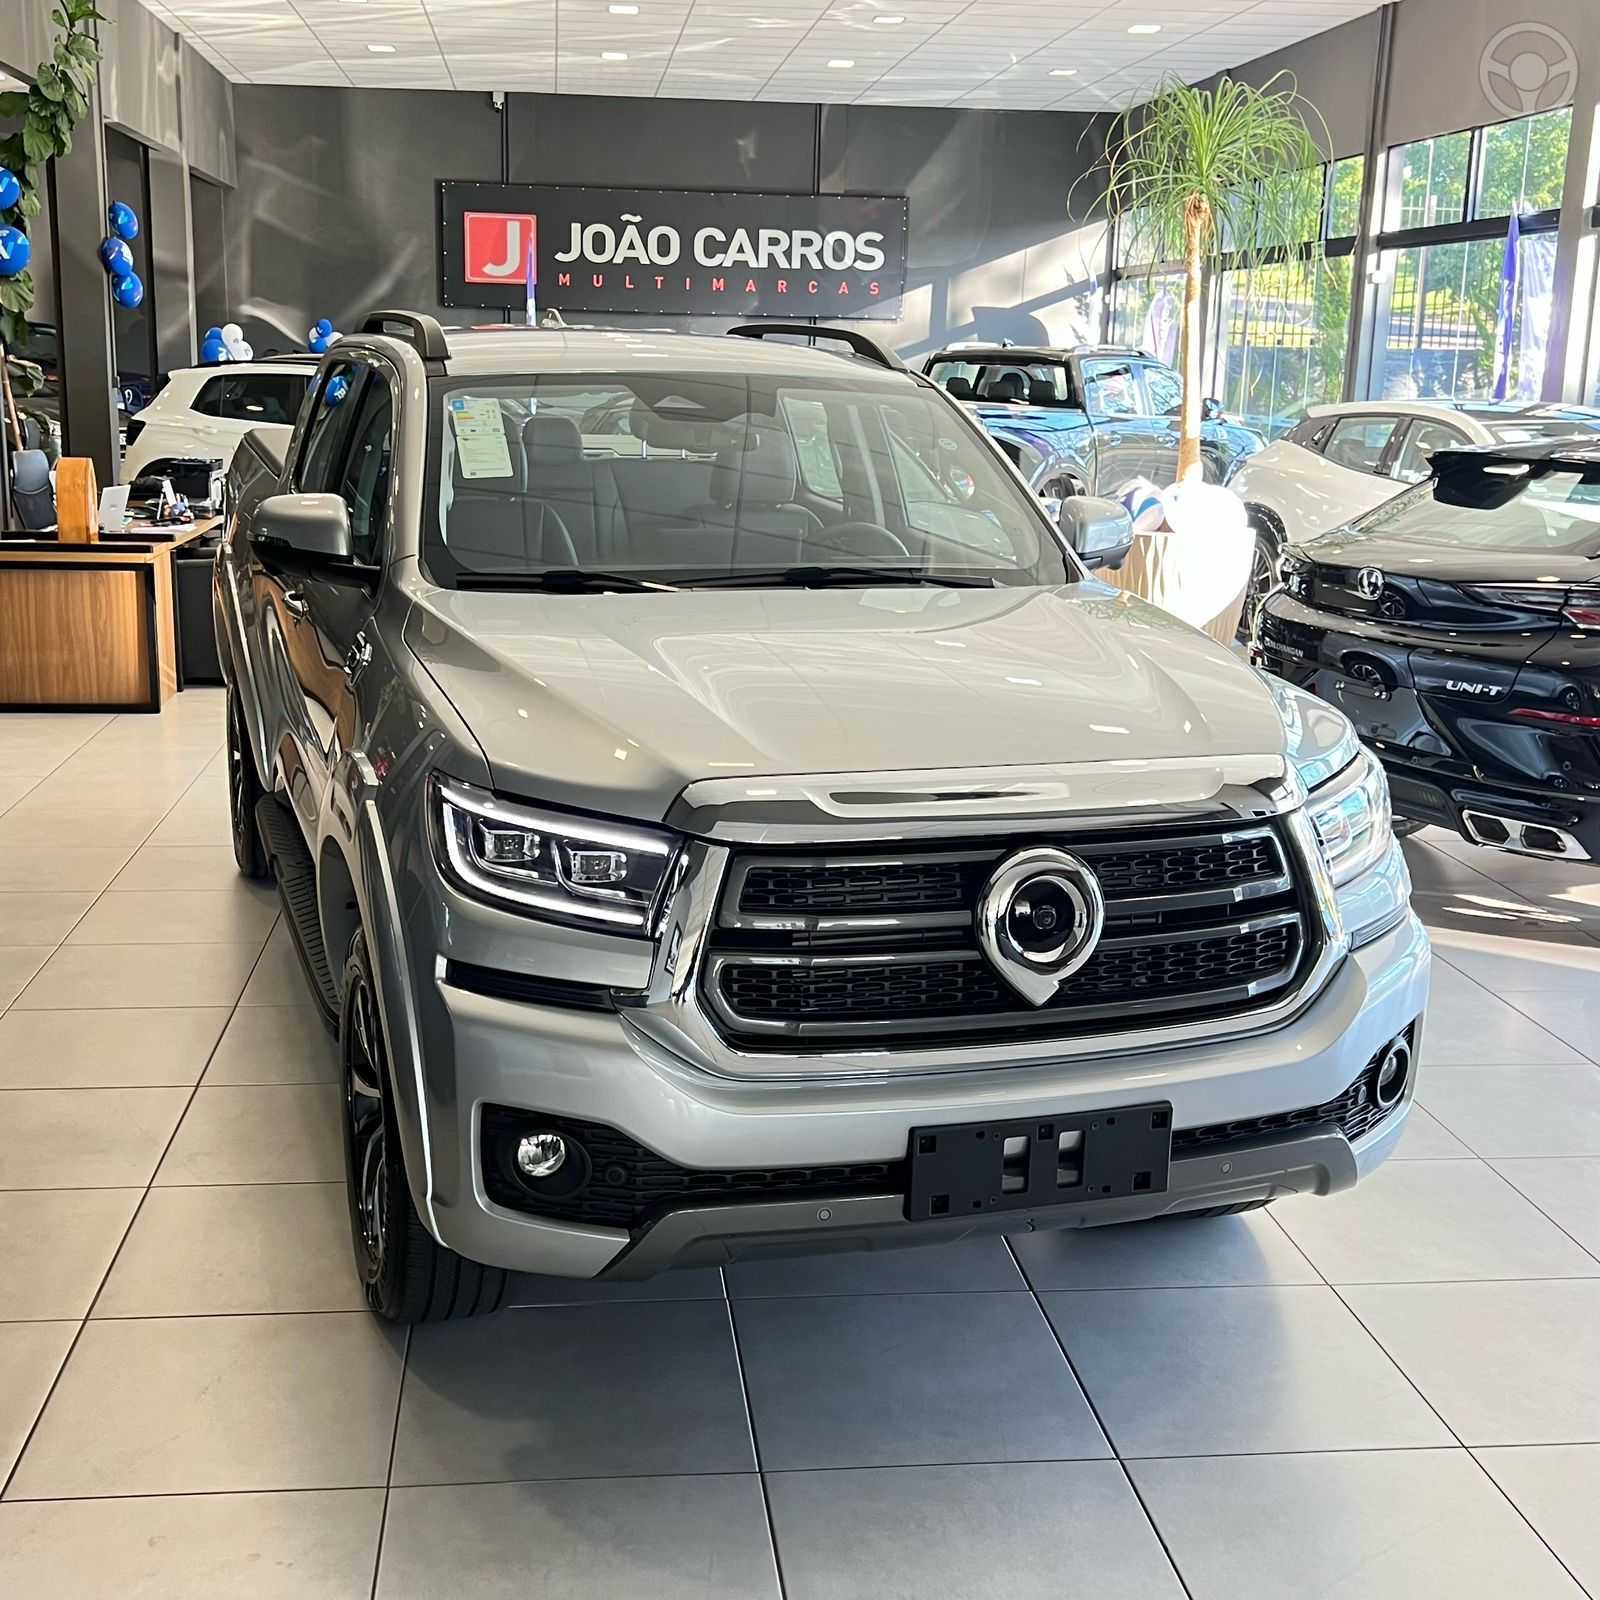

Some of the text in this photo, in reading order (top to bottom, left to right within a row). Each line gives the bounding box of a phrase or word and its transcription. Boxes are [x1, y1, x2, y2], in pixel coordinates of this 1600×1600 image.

[481, 221, 519, 277] J
[554, 213, 885, 271] JOÃO CARROS
[558, 273, 881, 296] MULTIMARCAS
[1446, 680, 1502, 696] UNI-T
